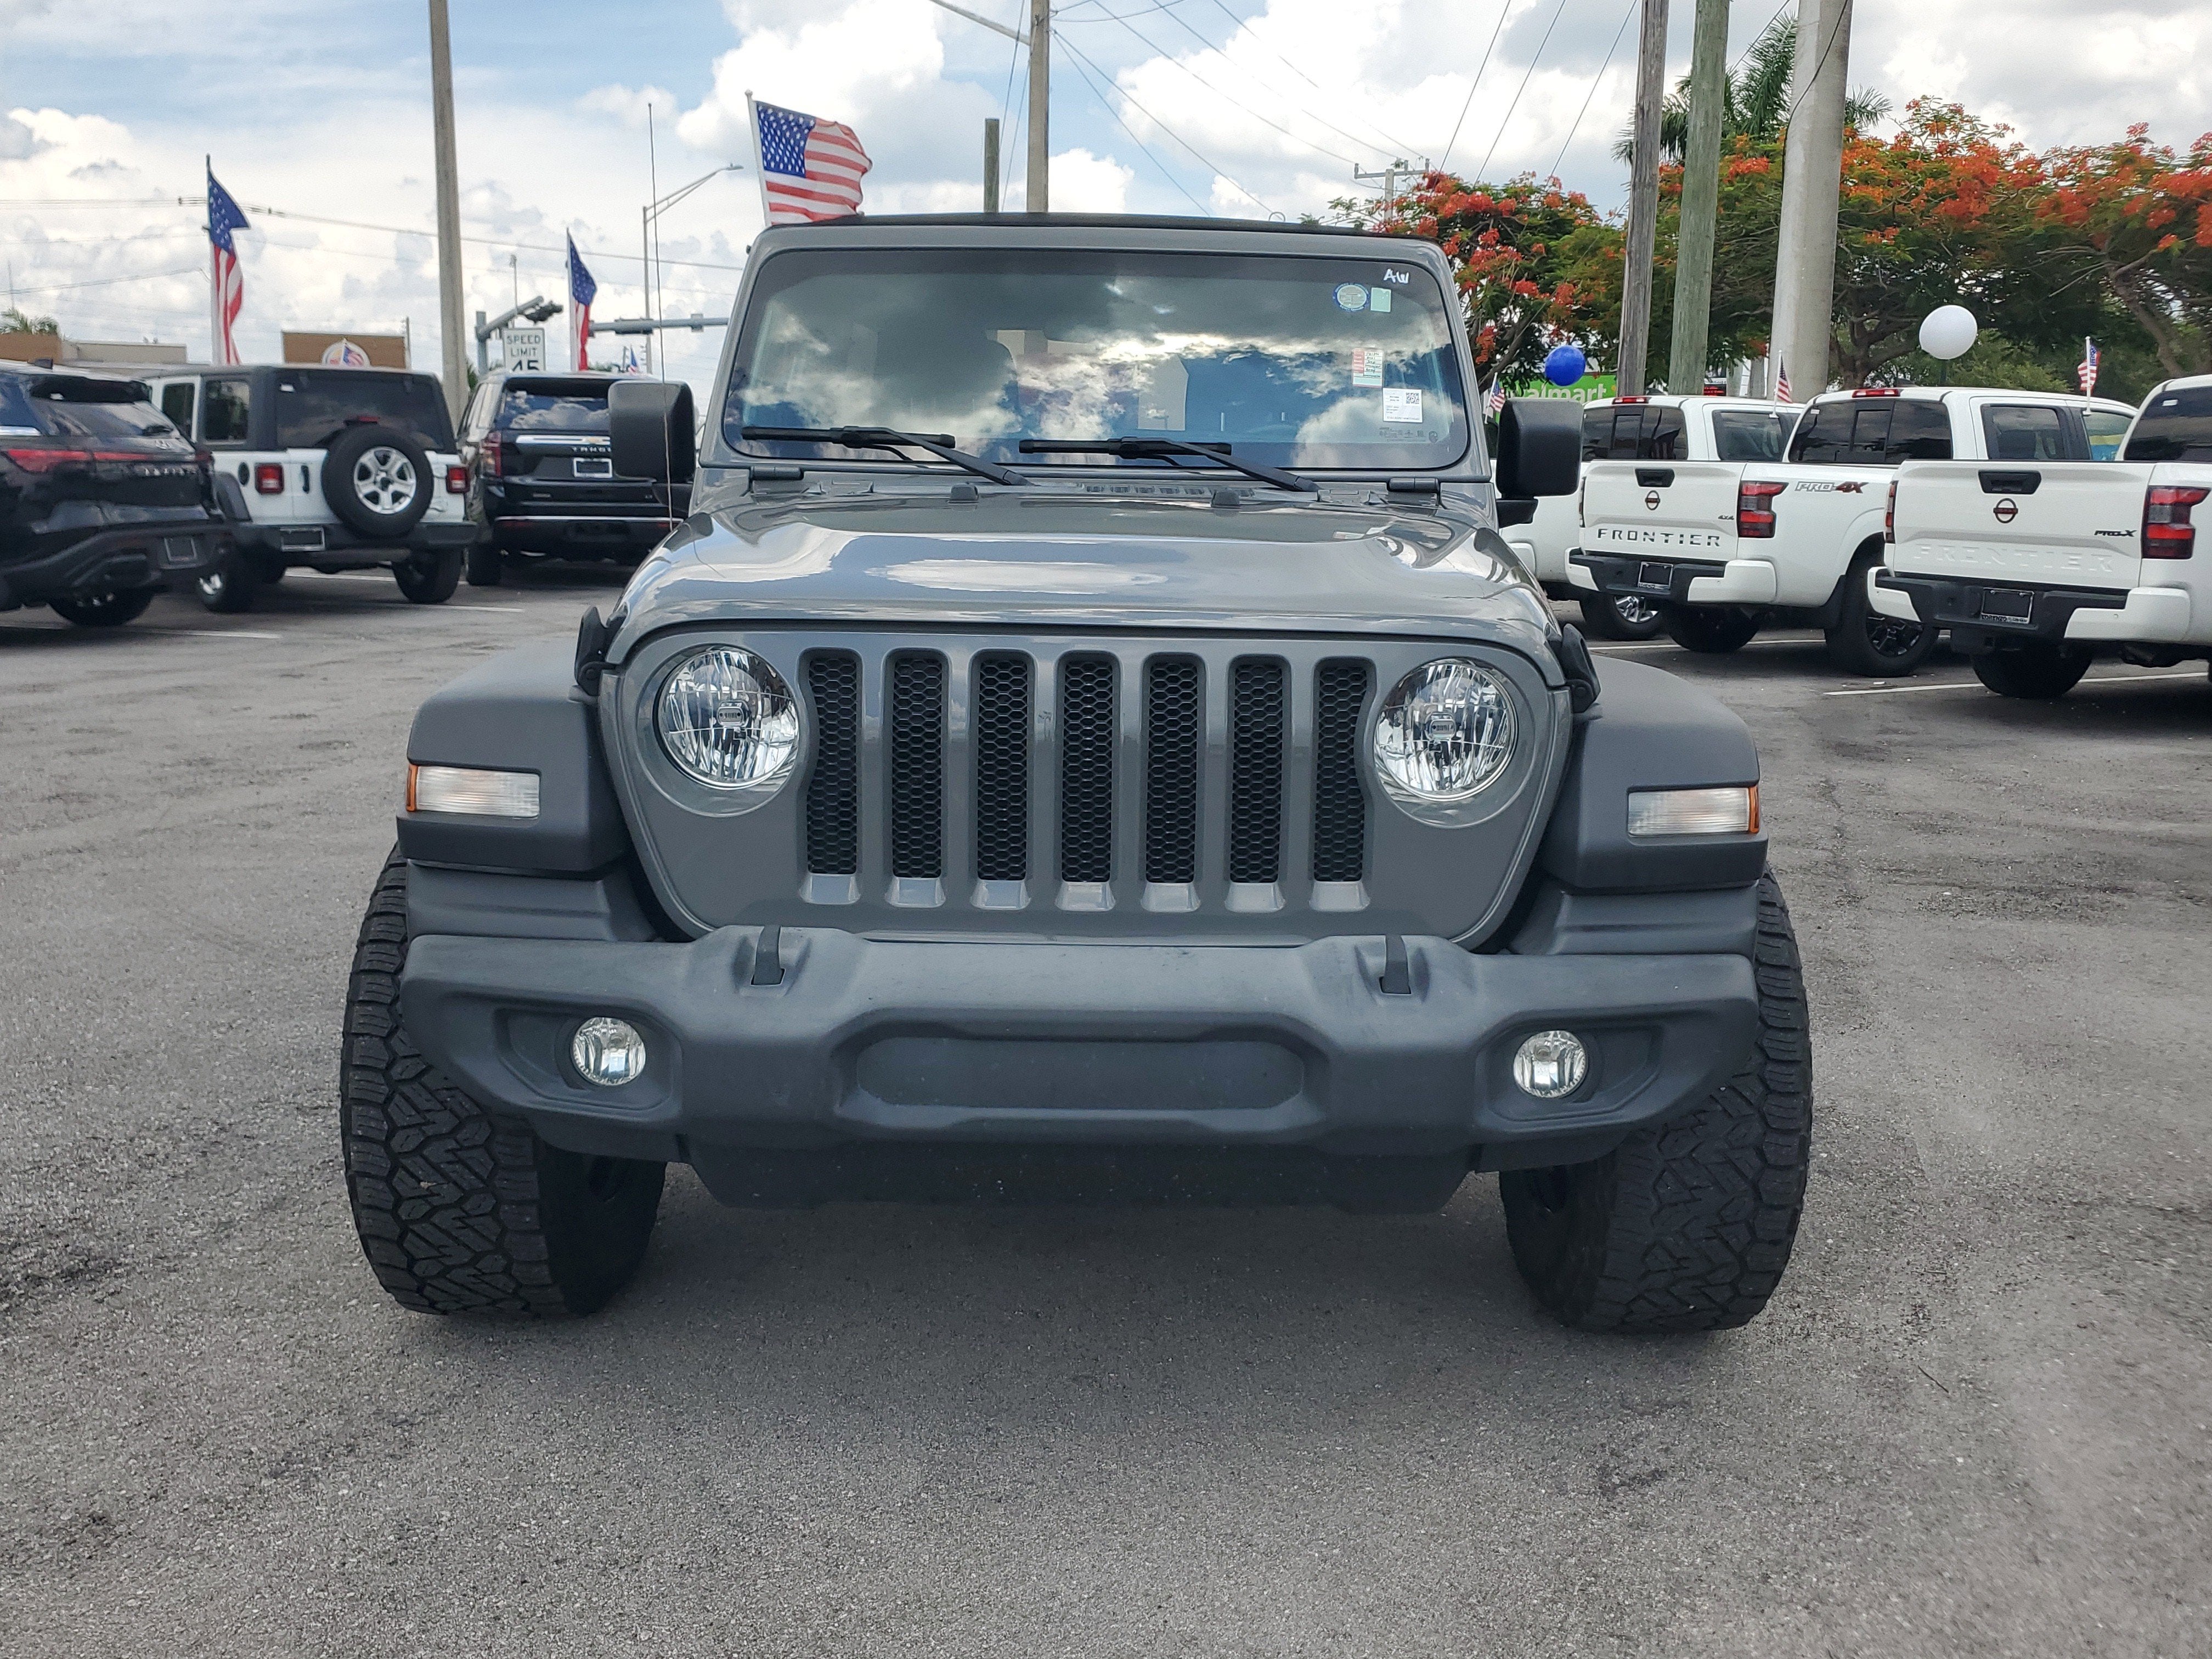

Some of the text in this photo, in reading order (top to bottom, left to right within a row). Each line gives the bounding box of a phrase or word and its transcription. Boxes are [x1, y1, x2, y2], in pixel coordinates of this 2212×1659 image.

[506, 335, 541, 345] SPEED
[511, 347, 537, 358] LIMIT
[1522, 383, 1607, 404] almart
[1597, 528, 1720, 547] FRONTIER
[1912, 543, 2114, 573] FRONTIER
